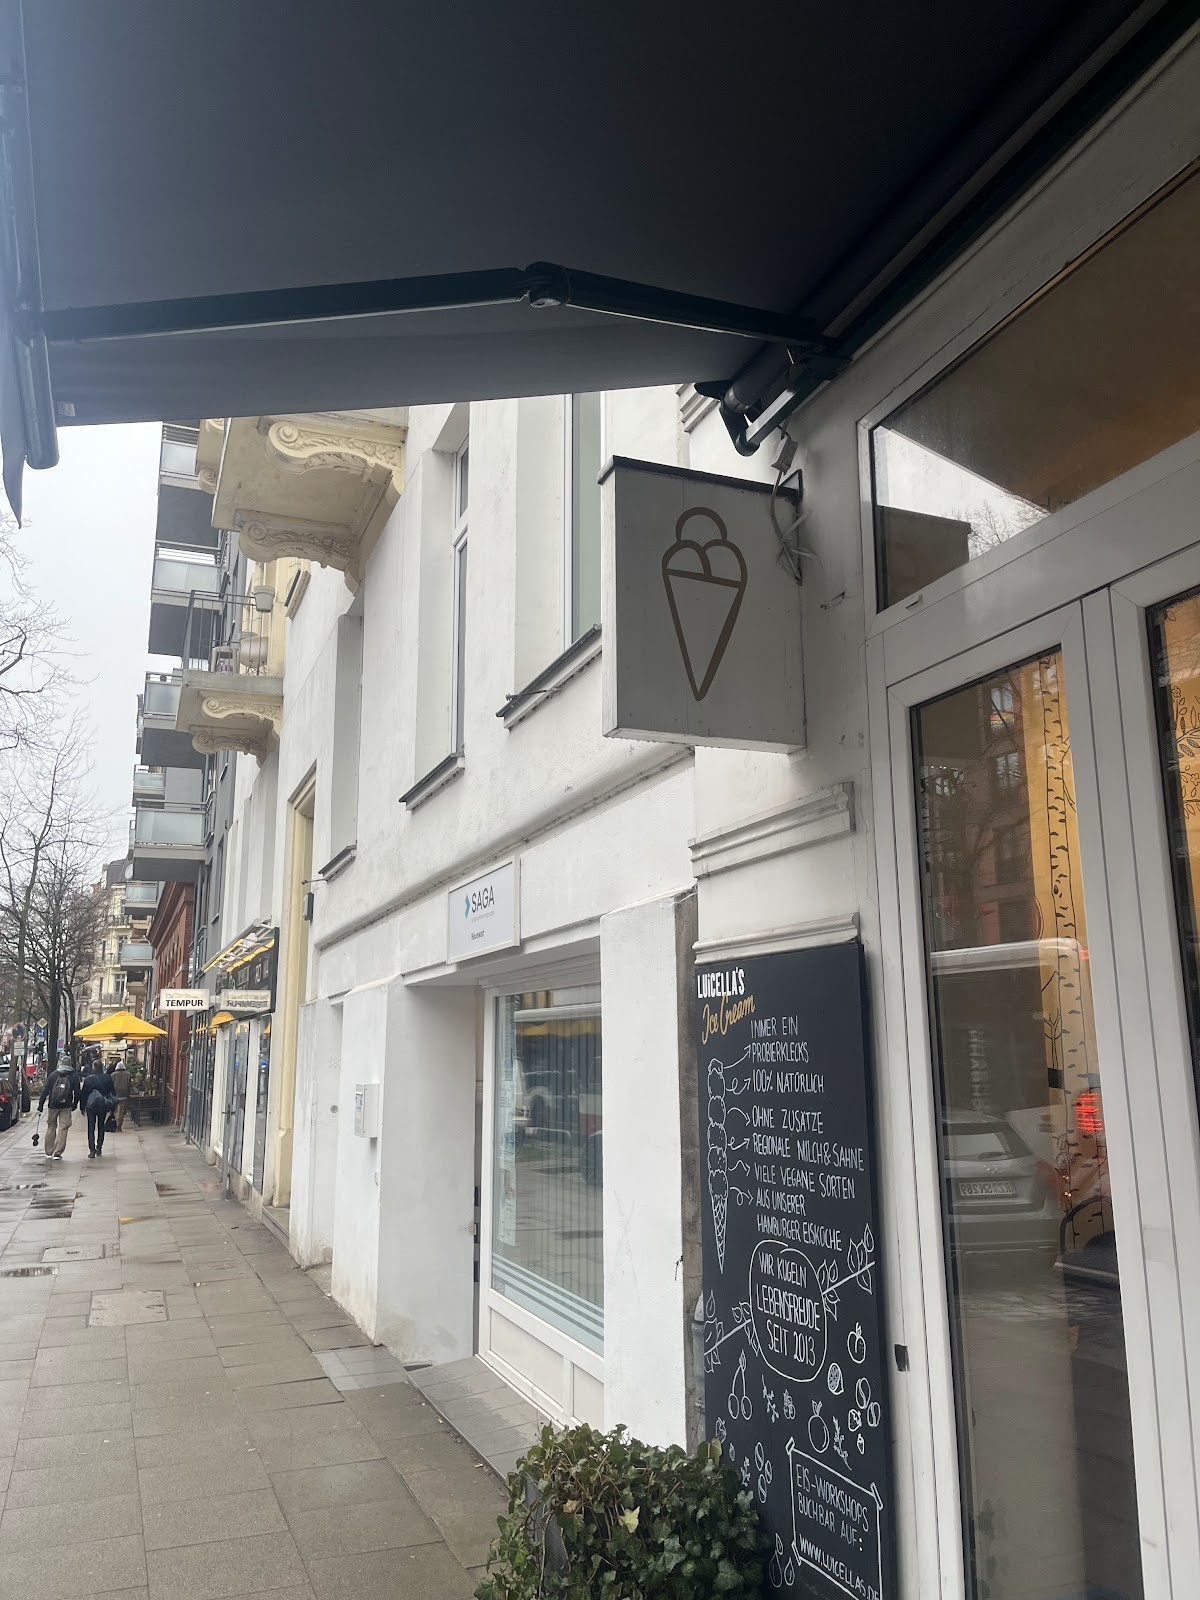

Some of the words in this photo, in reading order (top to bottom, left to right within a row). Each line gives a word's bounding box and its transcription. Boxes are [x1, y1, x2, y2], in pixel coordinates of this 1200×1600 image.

[471, 885, 495, 913] SAGA
[165, 999, 204, 1007] TEMPUR
[720, 994, 756, 1036] Cream
[750, 1017, 777, 1039] IMMER
[782, 1015, 798, 1036] EIN
[752, 1041, 809, 1063] PROBIERKLECKS
[752, 1069, 773, 1093] 100%
[776, 1071, 825, 1094] NATÜRLICH
[752, 1105, 775, 1129] OHNE
[752, 1132, 791, 1158] REGIONALE
[754, 1162, 777, 1185] VIELE
[780, 1166, 815, 1192] VEGANE
[819, 1173, 856, 1200] SORTEN
[756, 1187, 770, 1210] AUS
[771, 1190, 807, 1217] UNSERER
[756, 1213, 802, 1243] HAMBURGER
[758, 1251, 775, 1277] WIR
[776, 1256, 808, 1289] KUGELN
[756, 1283, 821, 1332] LEBENSFREUDE
[766, 1319, 789, 1356] SEIT
[793, 1331, 816, 1367] 2013
[796, 1463, 869, 1532] EIS-WORKSHOPS
[798, 1491, 836, 1533] BUCHBAR
